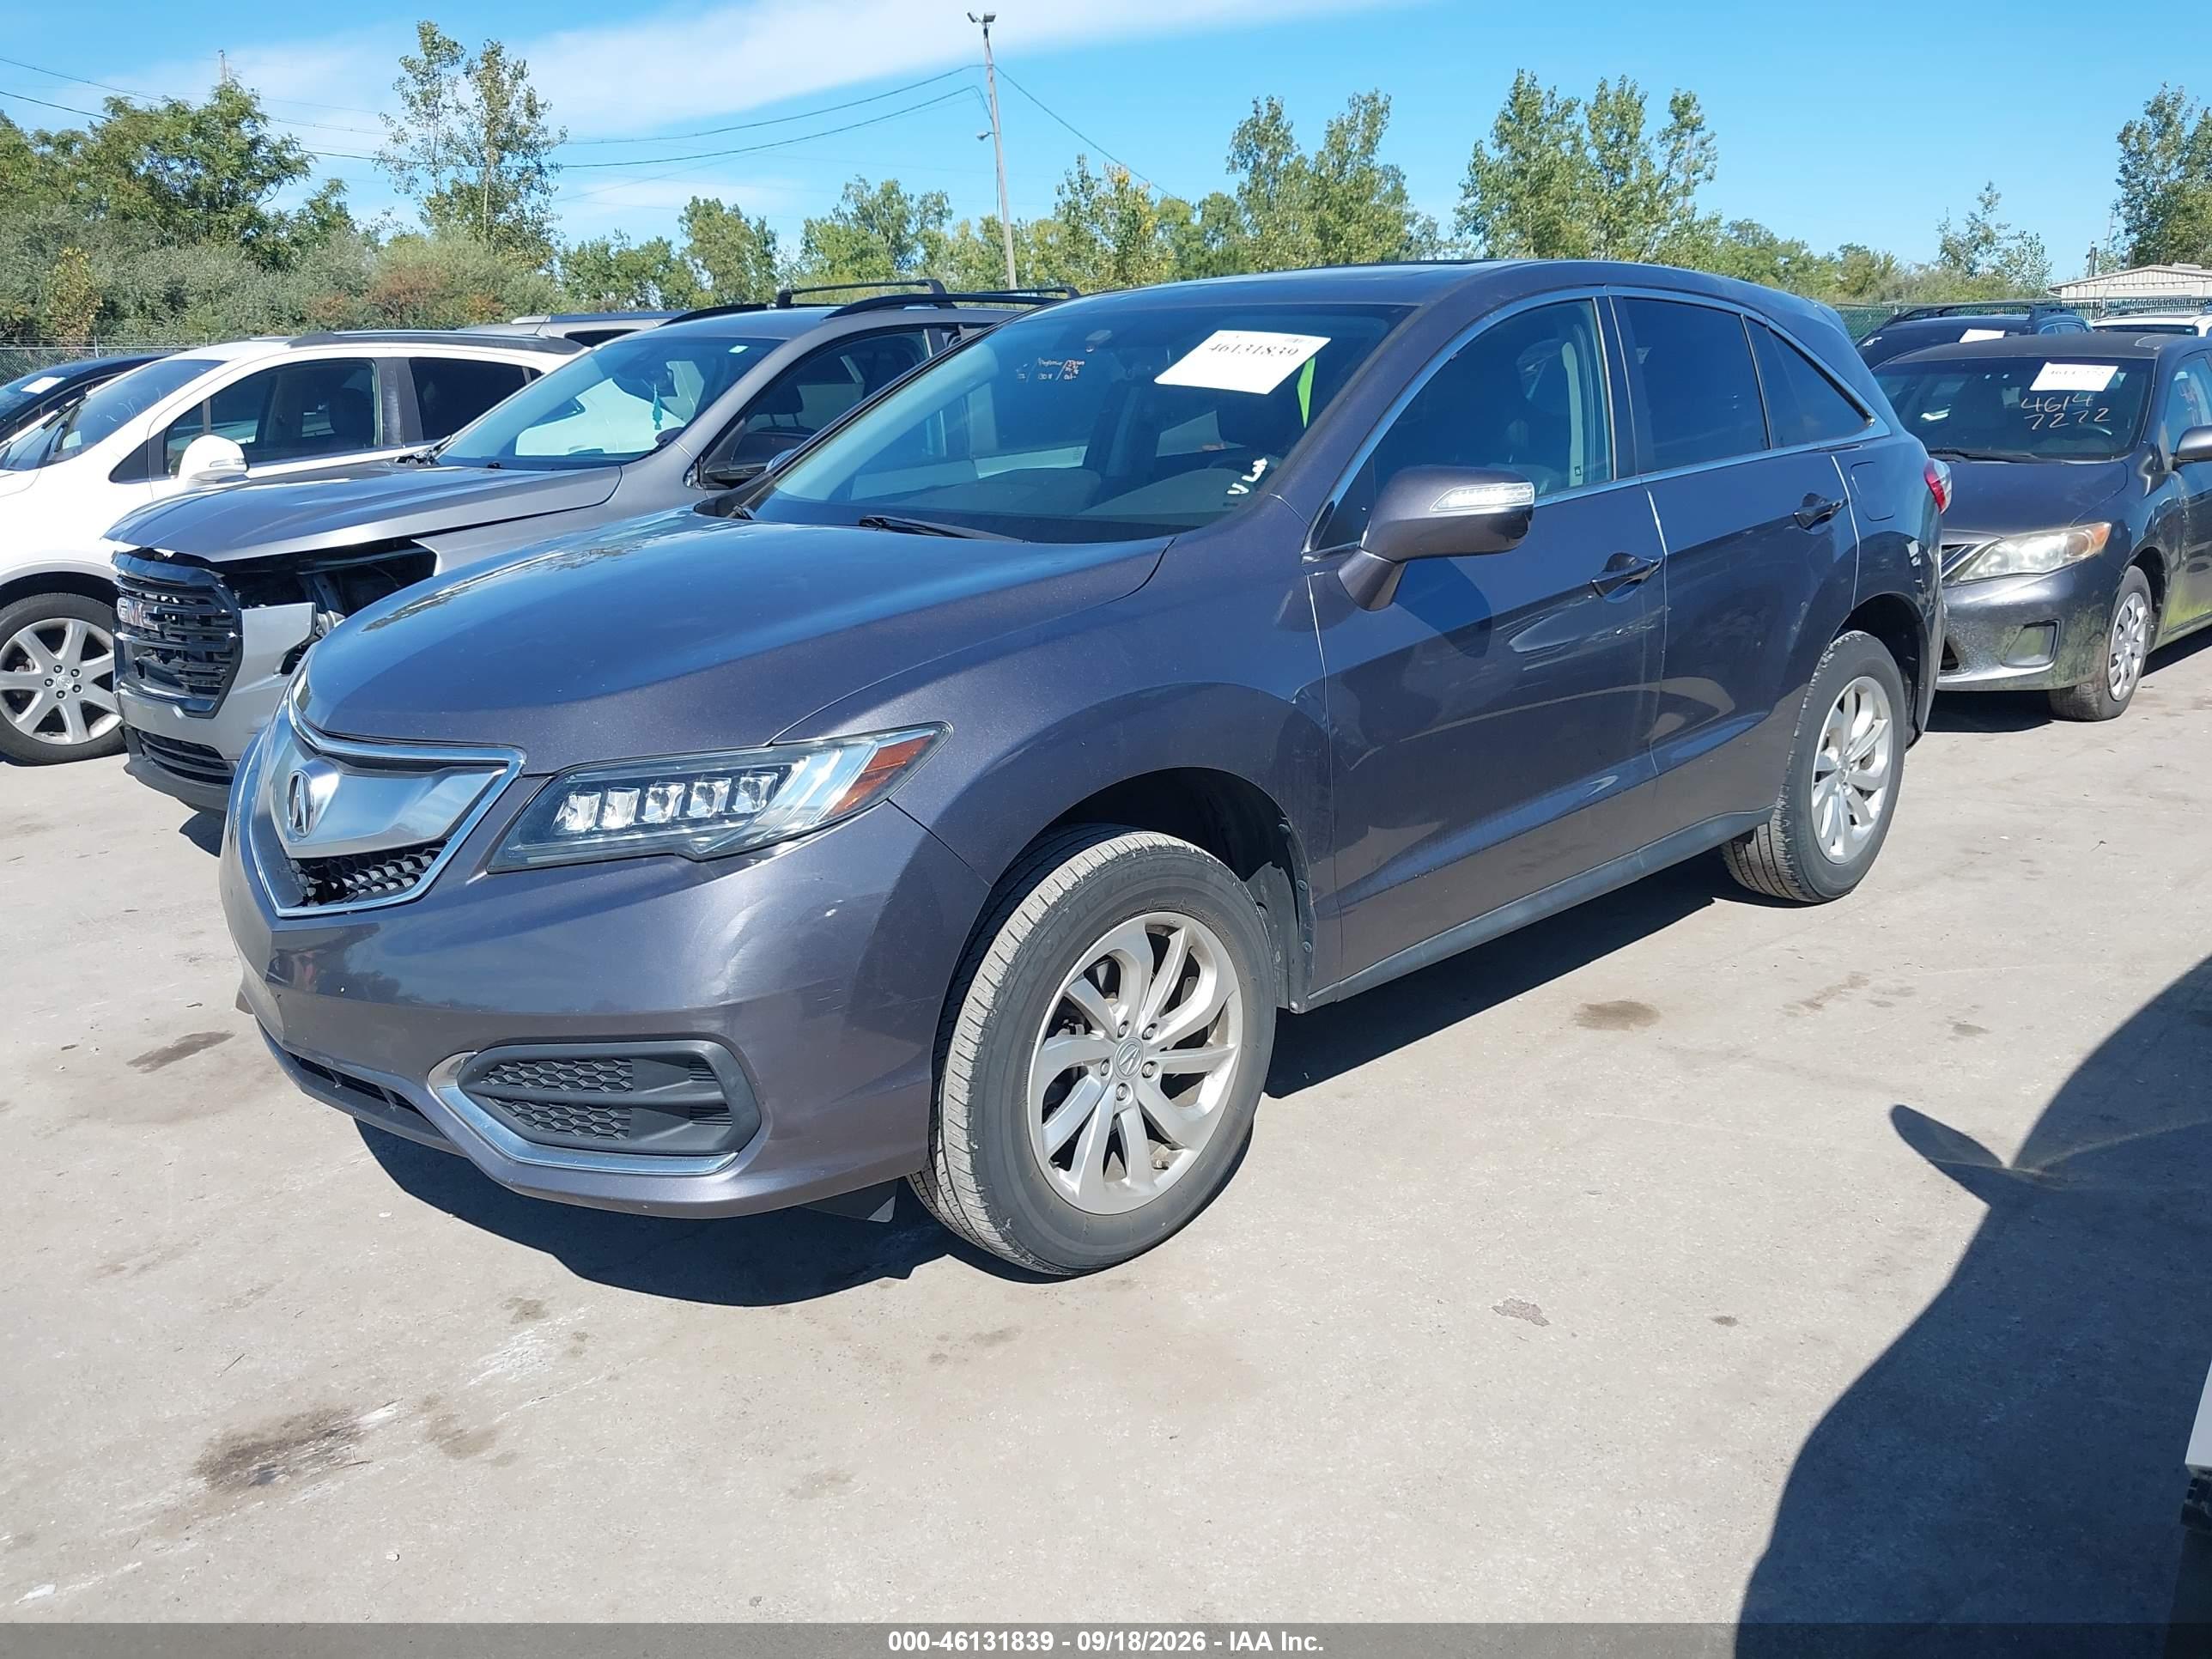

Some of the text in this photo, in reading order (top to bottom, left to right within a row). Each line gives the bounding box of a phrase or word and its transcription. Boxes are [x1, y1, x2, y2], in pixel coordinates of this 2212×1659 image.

[1208, 343, 1299, 358] 46131839
[2020, 392, 2094, 413] 4614
[2023, 407, 2112, 430] 7272
[117, 597, 160, 631] GMC
